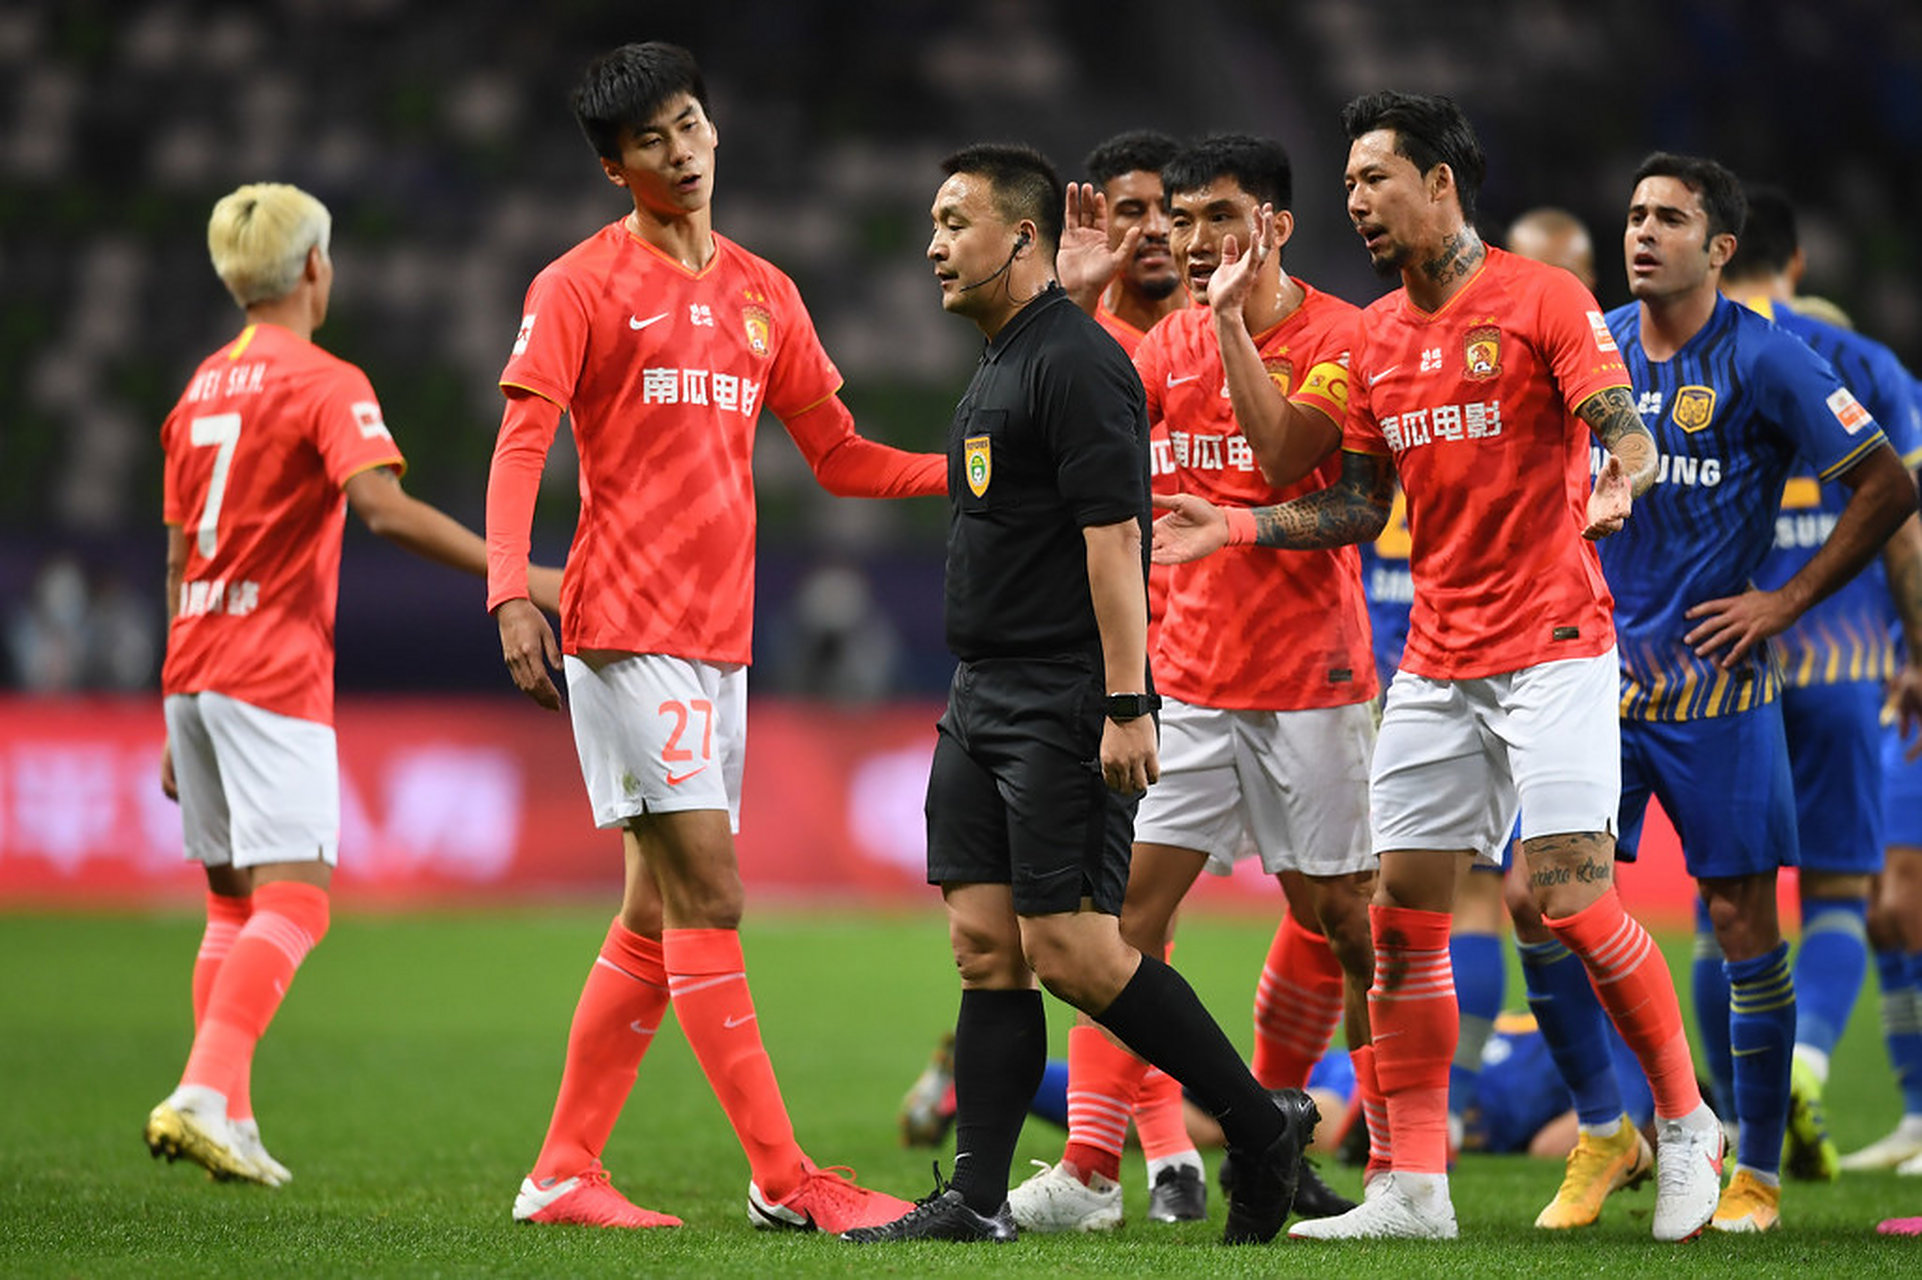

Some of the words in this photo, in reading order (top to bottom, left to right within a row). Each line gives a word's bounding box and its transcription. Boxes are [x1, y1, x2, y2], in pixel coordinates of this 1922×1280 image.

[1170, 431, 1256, 472] 南瓜电
[191, 412, 242, 561] 7
[659, 699, 712, 762] 27
